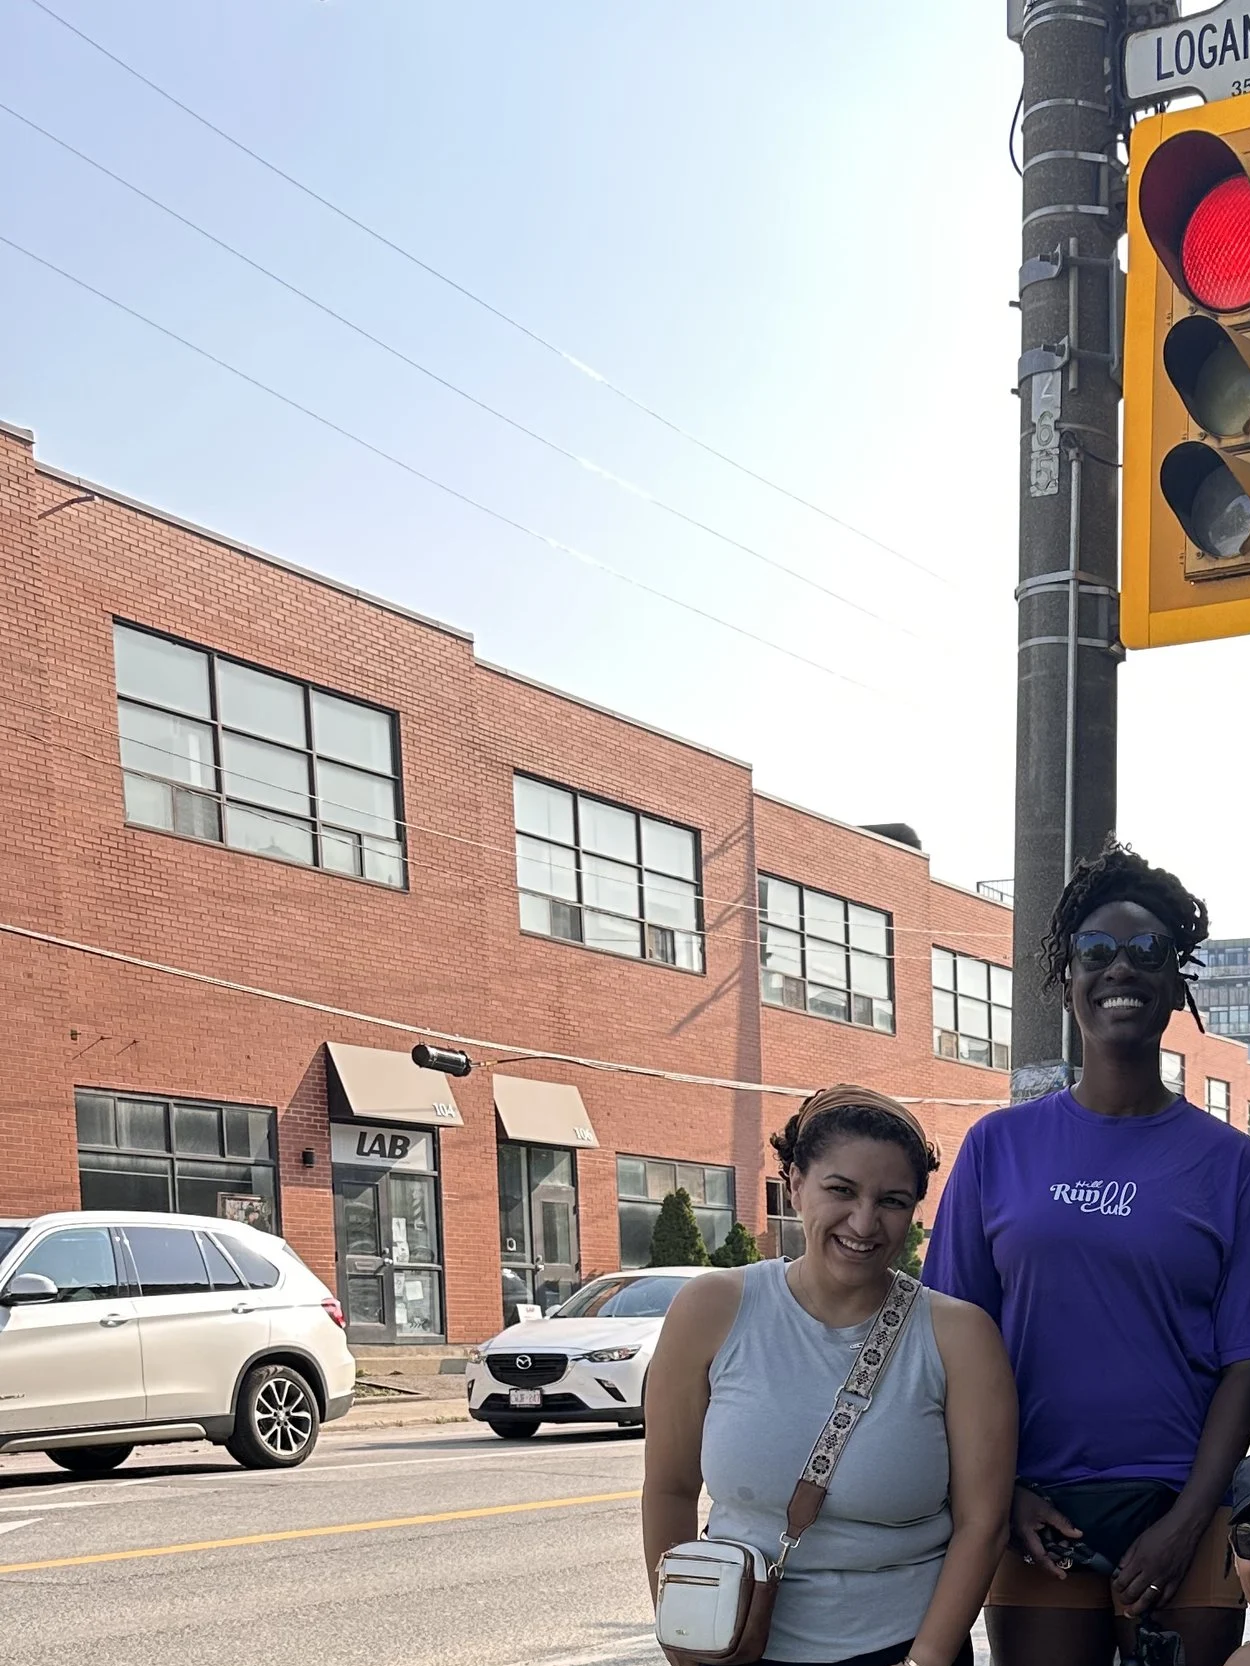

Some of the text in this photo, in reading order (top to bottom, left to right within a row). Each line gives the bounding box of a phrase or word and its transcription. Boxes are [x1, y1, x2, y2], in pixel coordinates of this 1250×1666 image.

[432, 1103, 456, 1118] 104
[356, 1131, 411, 1159] LAB
[1049, 1183, 1101, 1205] Run
